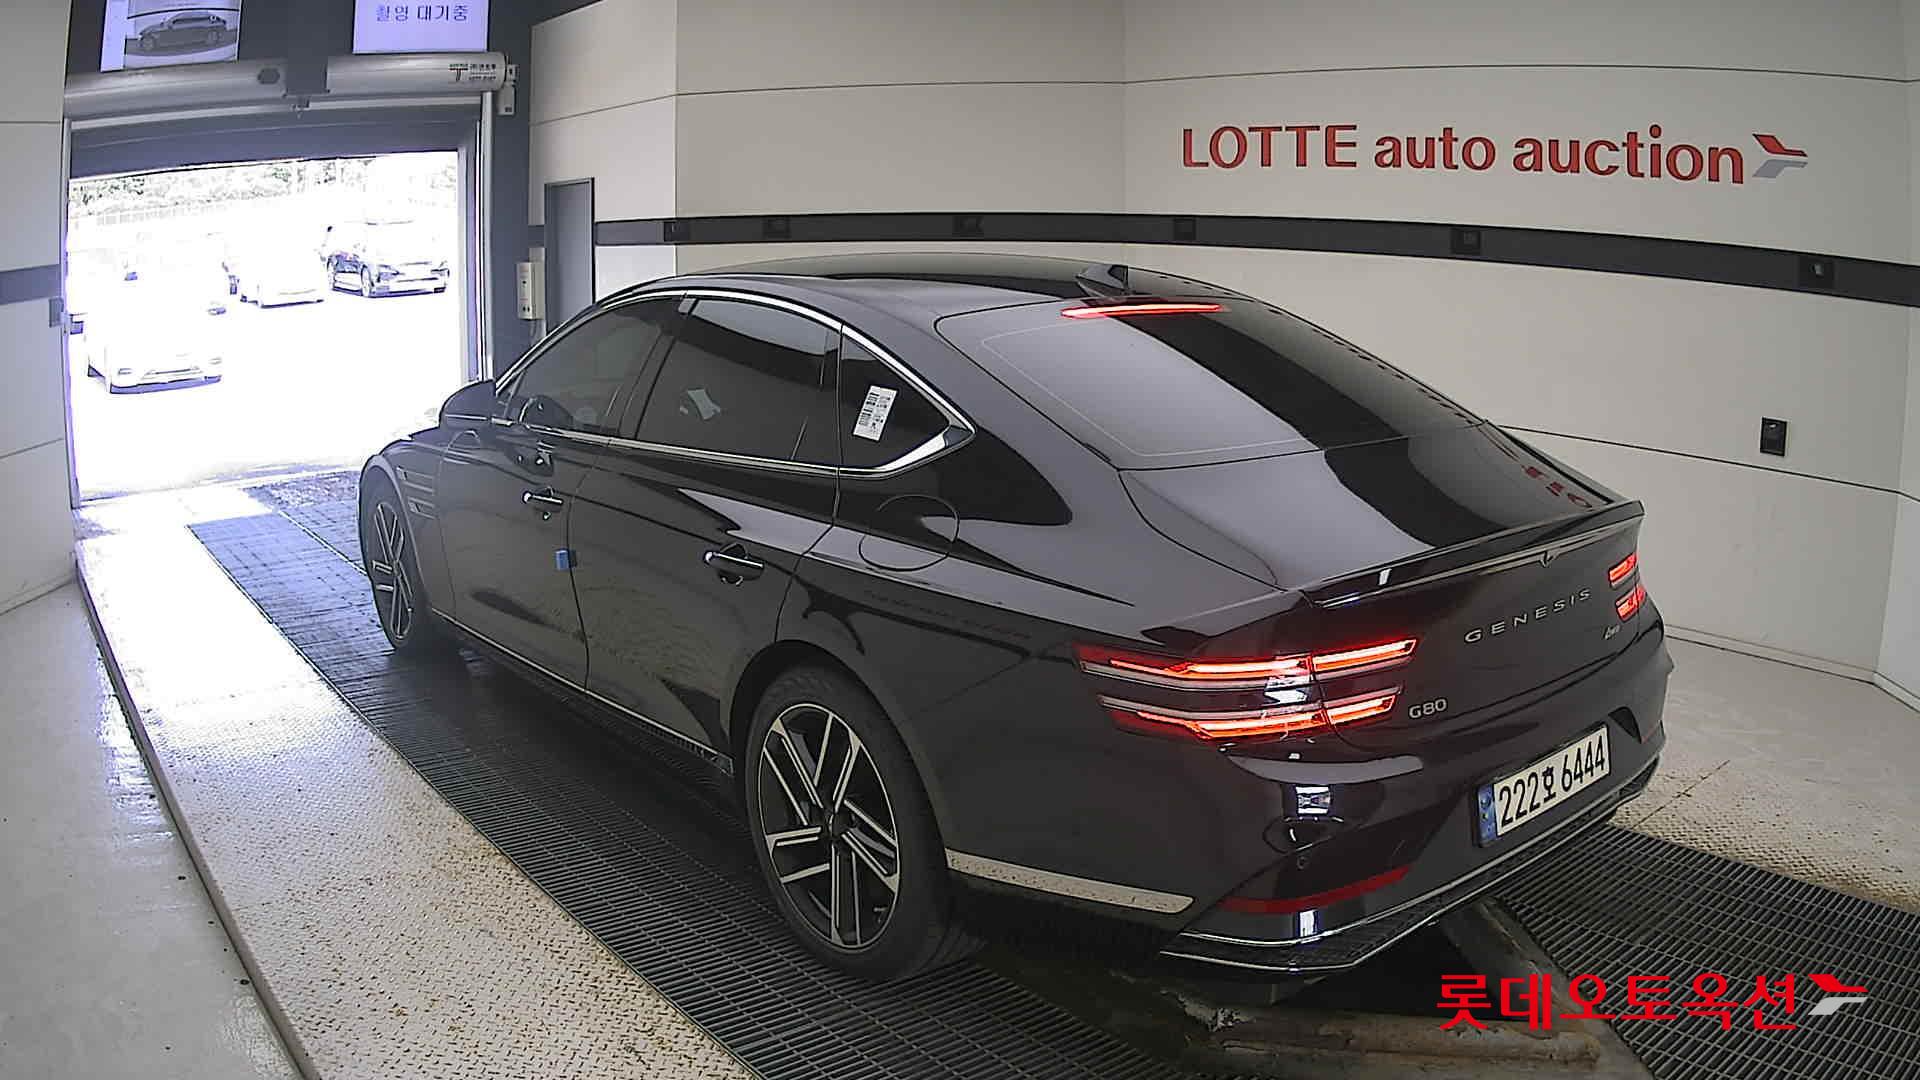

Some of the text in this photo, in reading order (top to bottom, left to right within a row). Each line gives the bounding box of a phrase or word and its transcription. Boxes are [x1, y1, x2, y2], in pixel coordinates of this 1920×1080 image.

[416, 4, 469, 22] 대기중
[1183, 124, 1744, 185] LOTTE auto auction
[1464, 588, 1592, 643] GENESIS
[1408, 698, 1448, 720] G80
